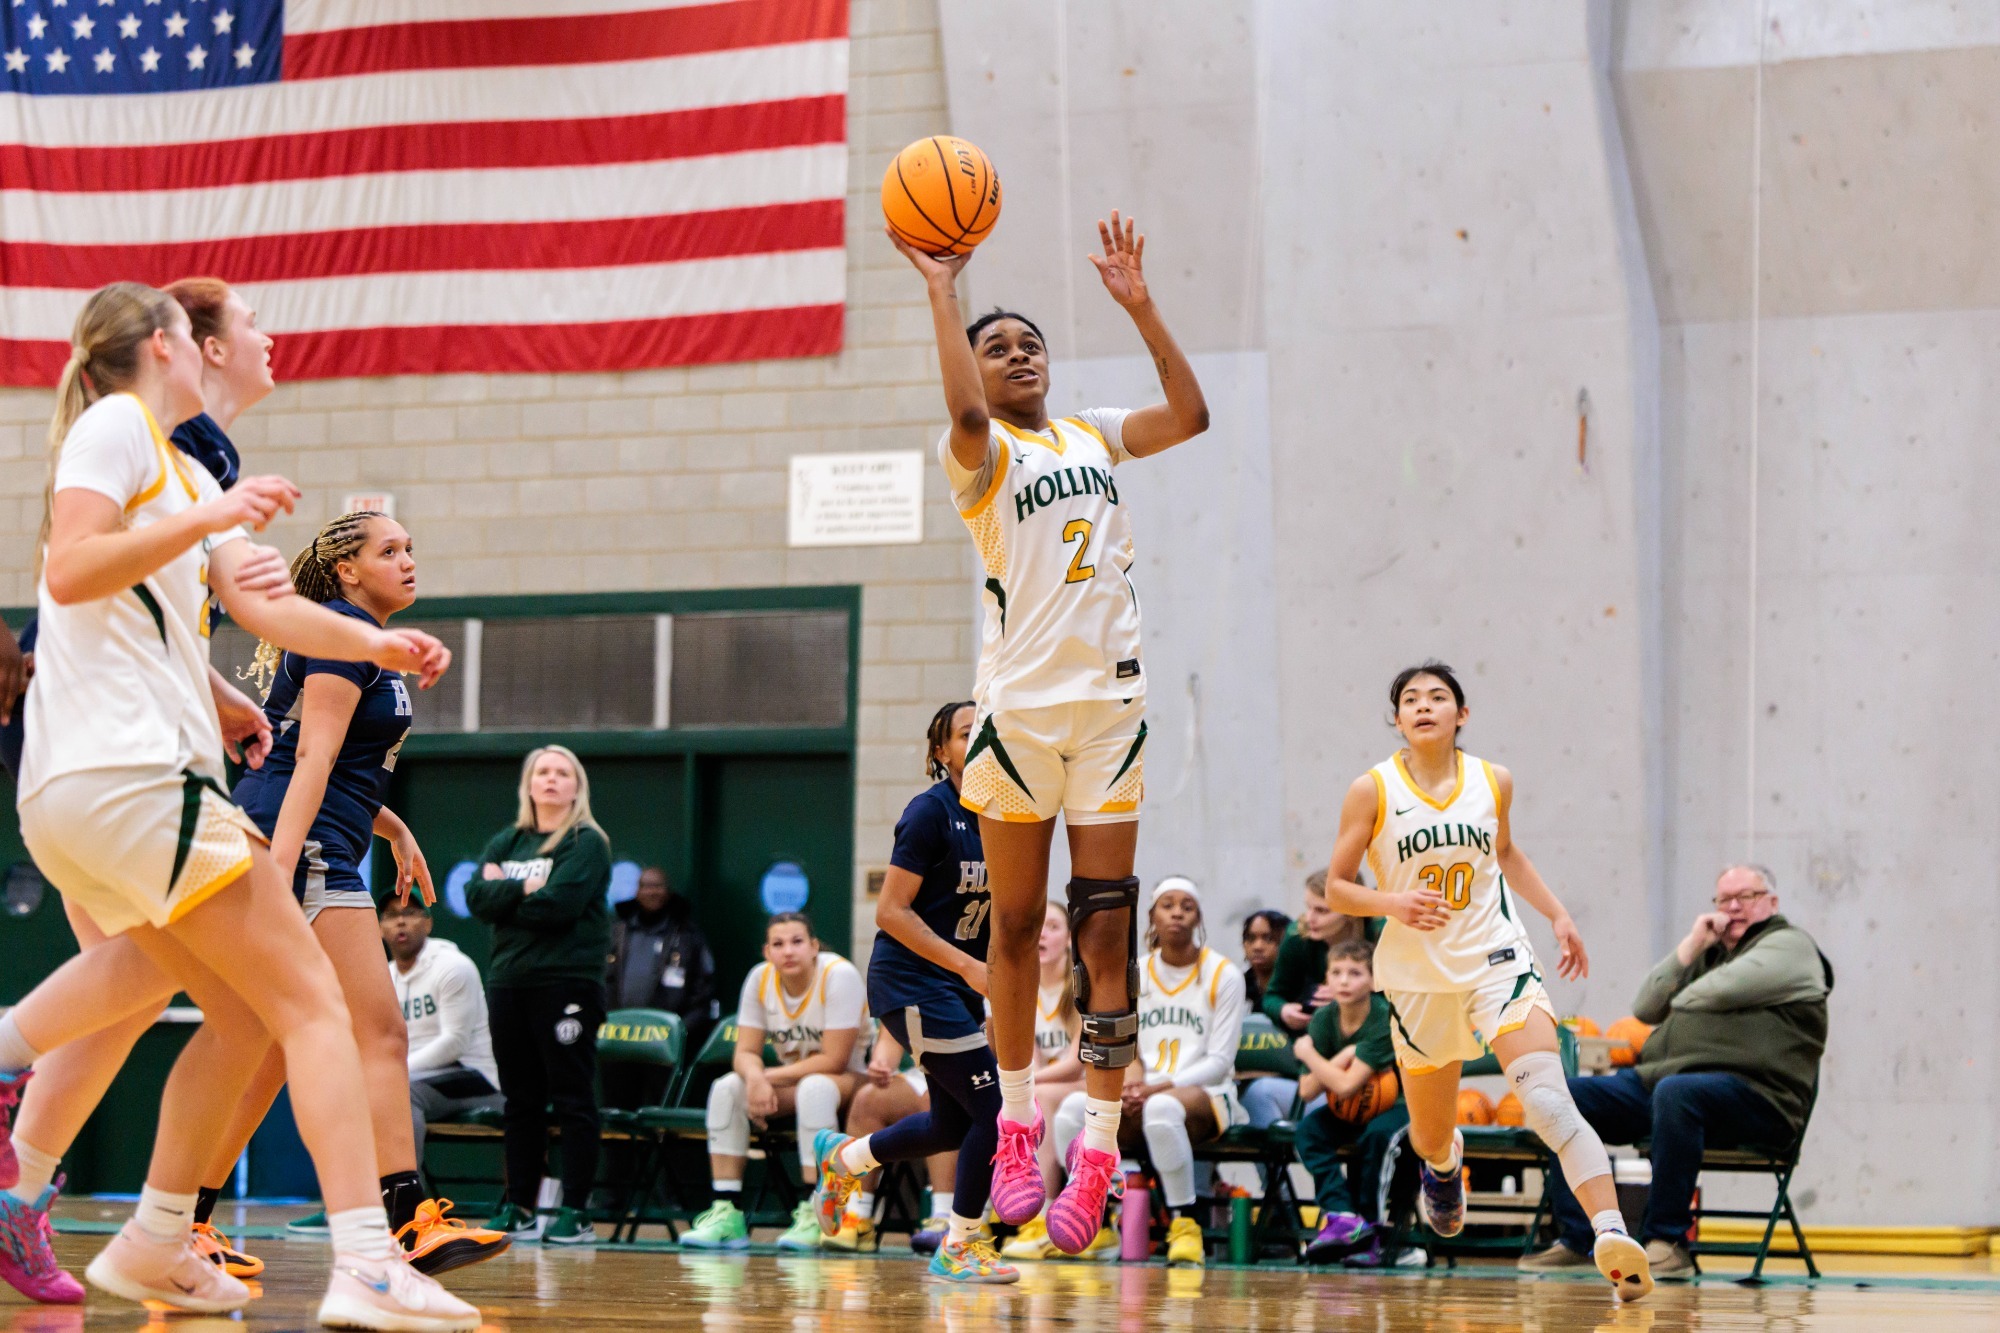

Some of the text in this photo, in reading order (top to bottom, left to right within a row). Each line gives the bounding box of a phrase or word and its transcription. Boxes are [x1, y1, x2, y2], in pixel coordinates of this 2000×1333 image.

[1014, 466, 1119, 524] HOLLINS
[1063, 518, 1095, 584] 2
[1397, 823, 1491, 864] HOLLINS
[1418, 861, 1475, 911] 30
[955, 899, 991, 940] 21
[597, 1023, 671, 1042] HOLLINS
[1154, 1038, 1181, 1073] 11
